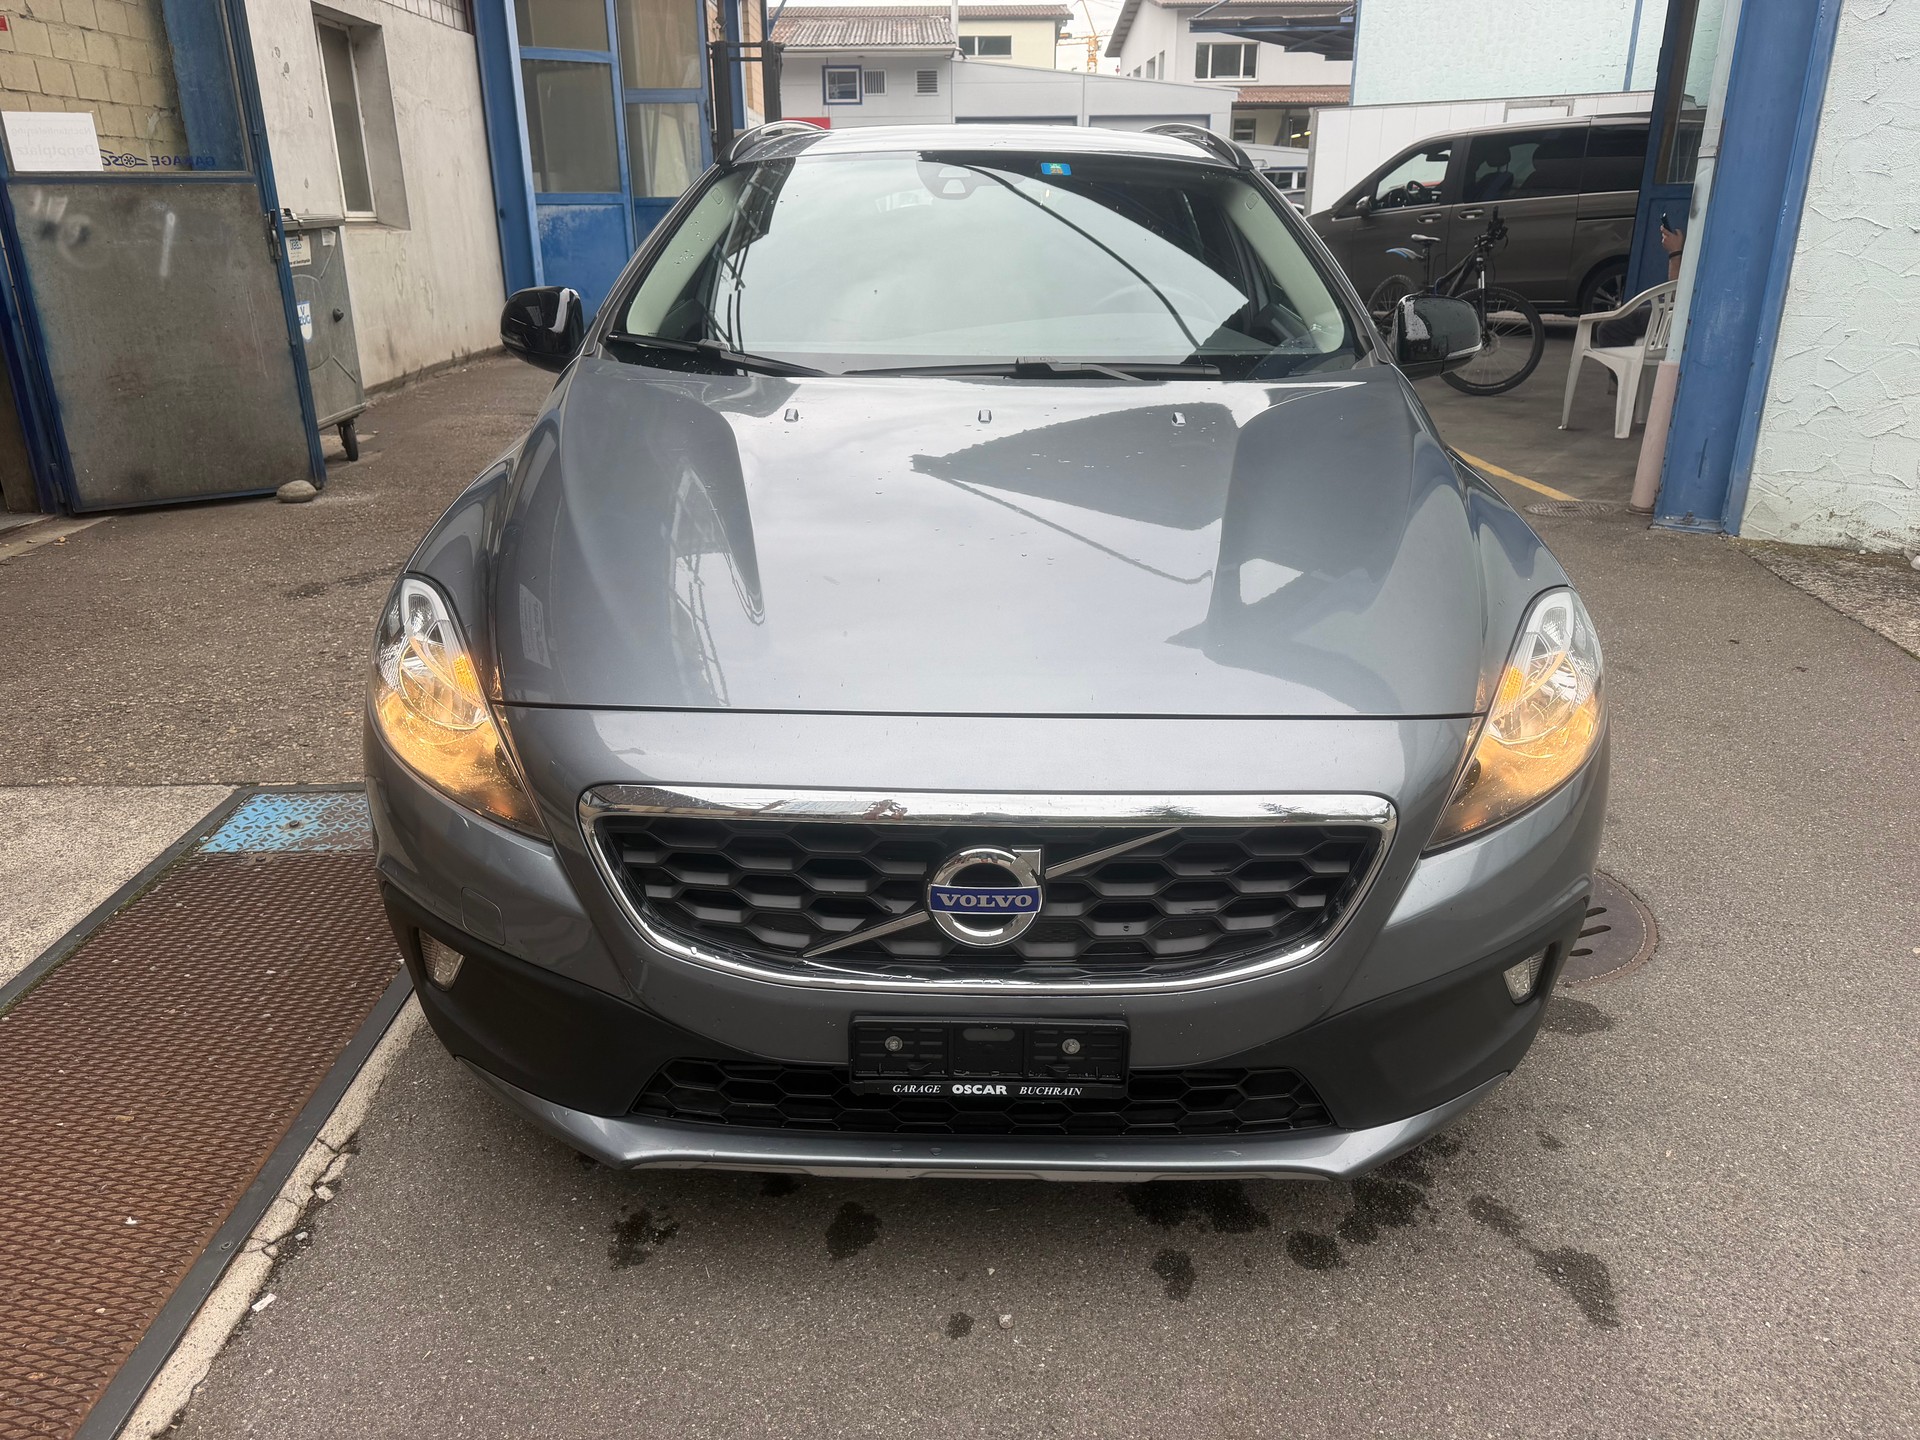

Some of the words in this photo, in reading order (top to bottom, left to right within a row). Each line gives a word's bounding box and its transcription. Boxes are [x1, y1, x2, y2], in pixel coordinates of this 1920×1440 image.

[937, 893, 1032, 908] VOLVO
[892, 1084, 941, 1094] GARAGE
[951, 1084, 1008, 1095] OSCAR
[1019, 1086, 1083, 1096] BUCHRAIN
